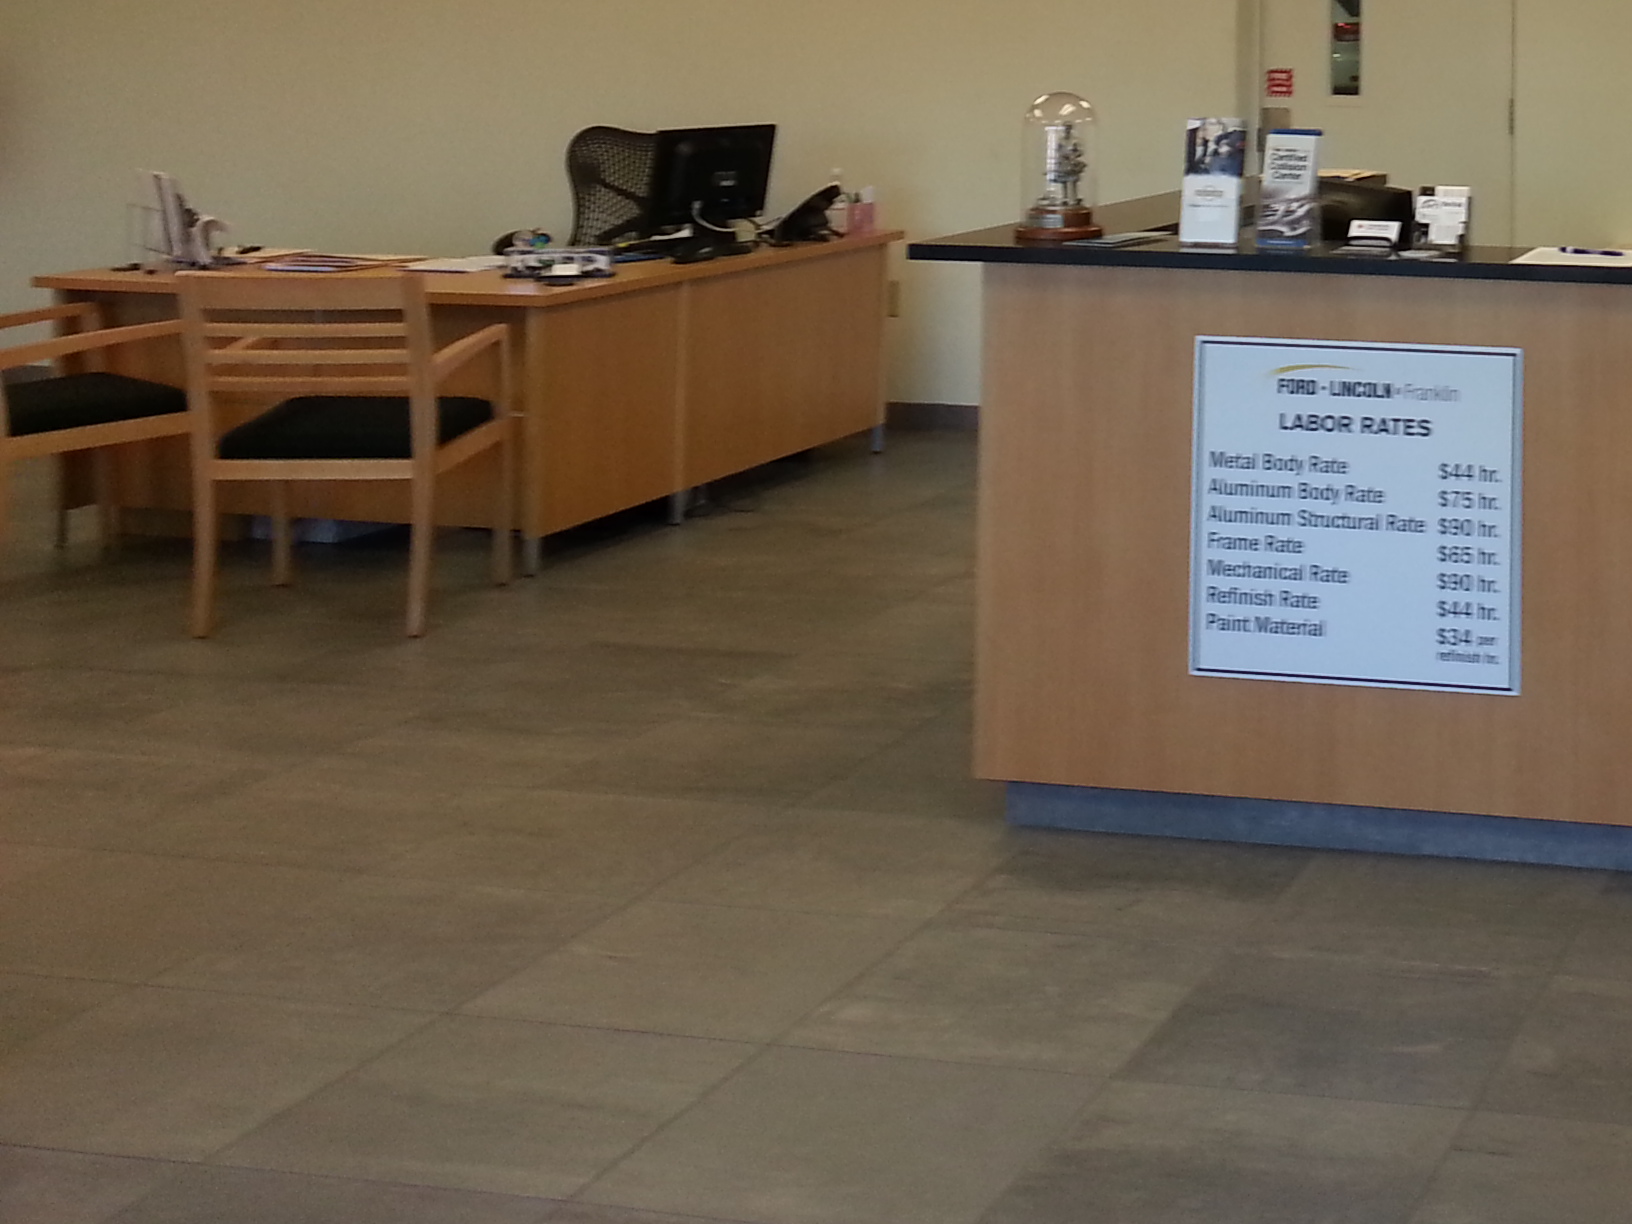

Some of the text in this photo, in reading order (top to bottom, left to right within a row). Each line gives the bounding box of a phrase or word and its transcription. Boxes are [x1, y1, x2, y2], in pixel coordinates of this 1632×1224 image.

[1277, 378, 1317, 395] FORD
[1330, 380, 1393, 399] LINCOLN
[1279, 413, 1433, 437] LABOR RATES
[1208, 450, 1349, 476] Metal Body Rate
[1437, 463, 1502, 483] $44 hr.
[1207, 479, 1385, 505] Aluminum Body Rate
[1437, 490, 1502, 511] $75 hr.
[1206, 506, 1427, 534] Aluminum Structural Rate
[1437, 517, 1501, 538] $90 hr.
[1206, 532, 1304, 554] Frame Rate
[1437, 545, 1501, 566] $65 hr.
[1206, 559, 1349, 584] Mechanical Rate
[1436, 573, 1501, 593] $90 hr.
[1206, 586, 1320, 609] Refinish Rate
[1436, 600, 1500, 621] $44 hr.
[1205, 613, 1326, 637] Paint Material
[1436, 628, 1472, 646] $34
